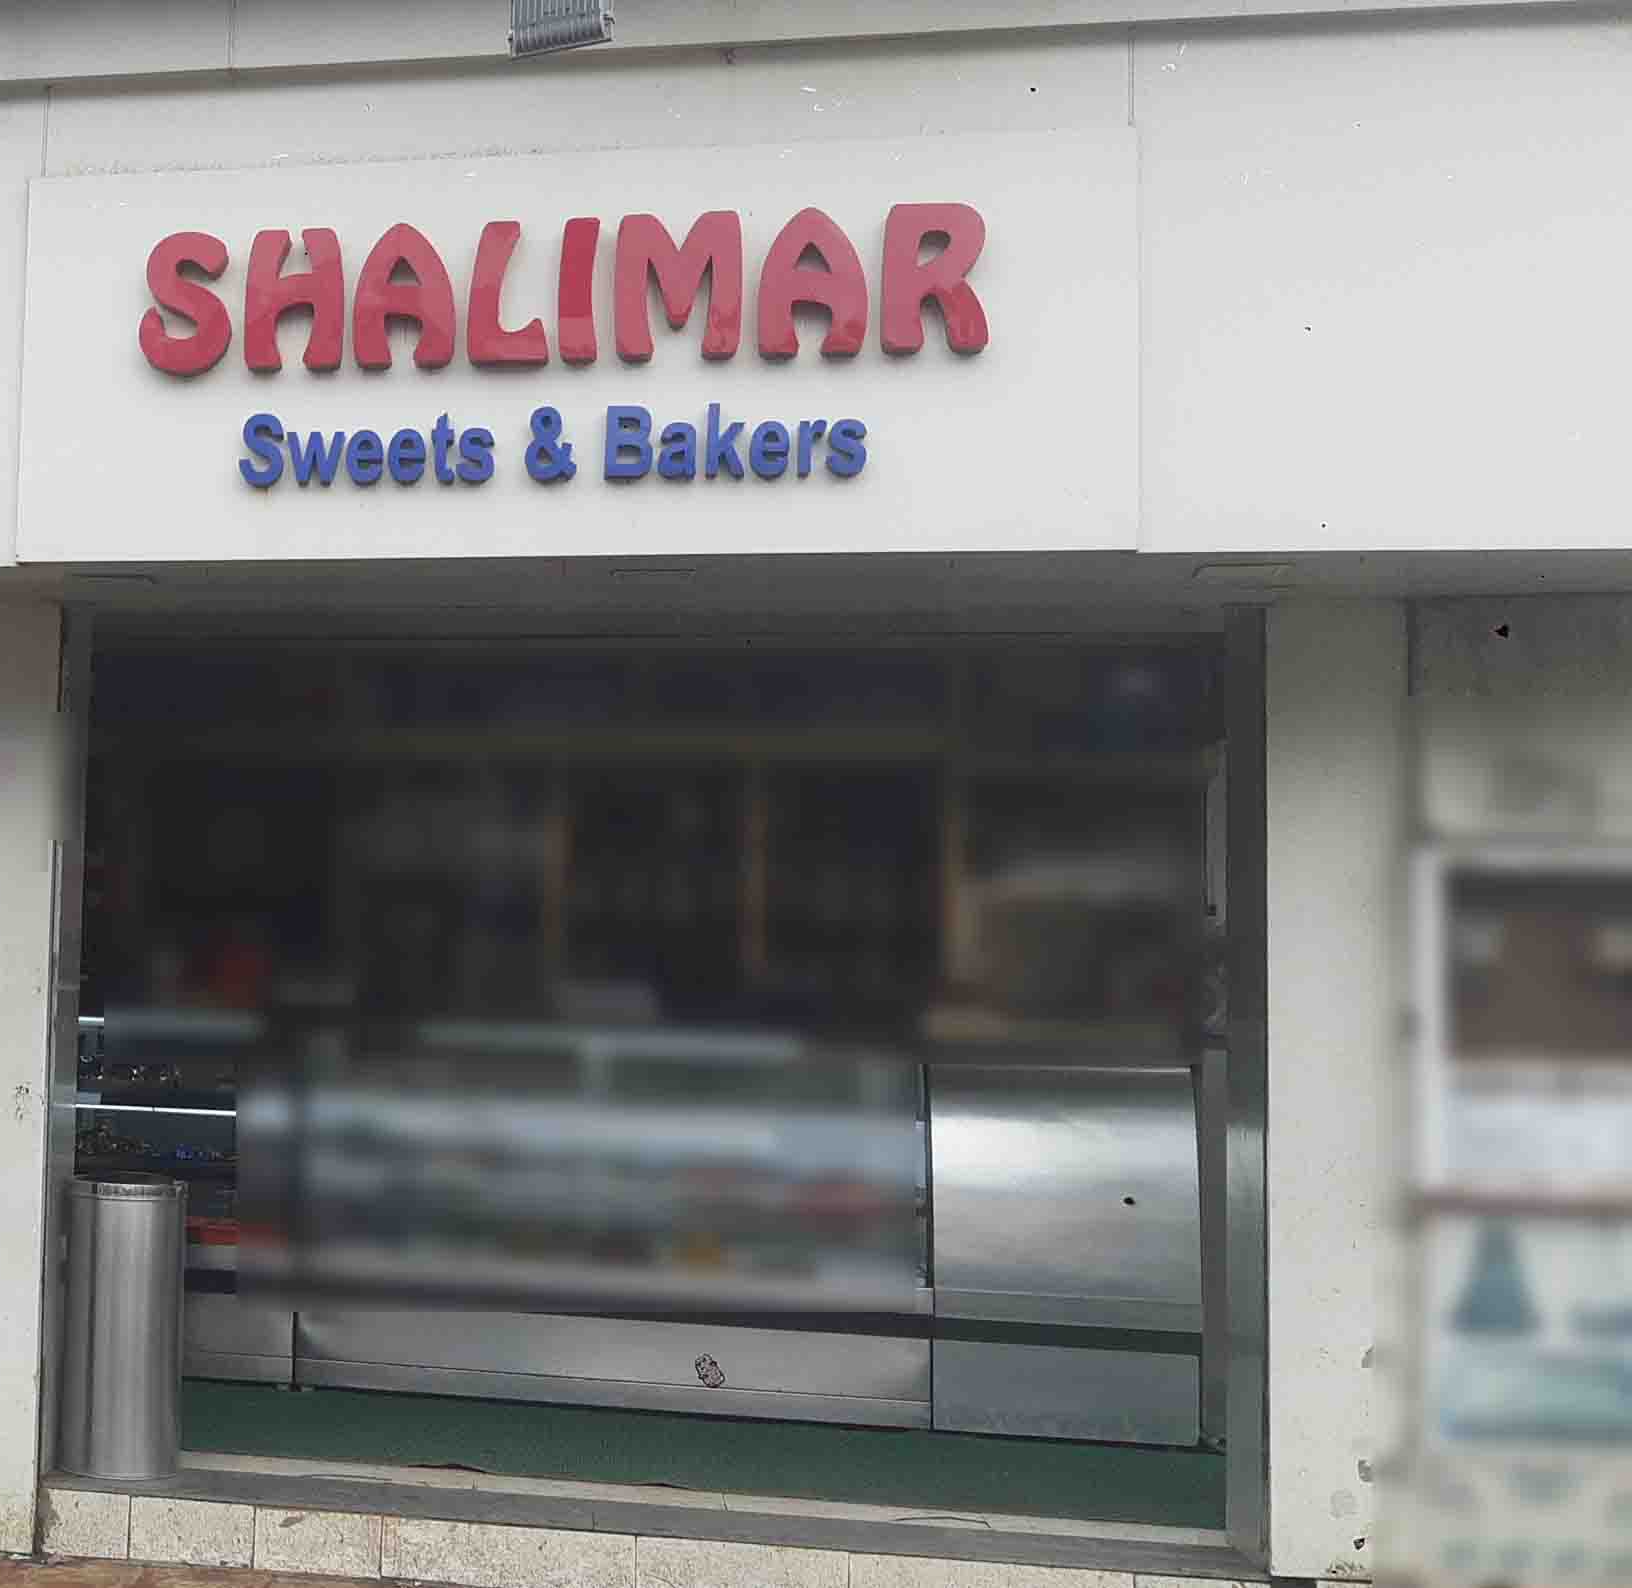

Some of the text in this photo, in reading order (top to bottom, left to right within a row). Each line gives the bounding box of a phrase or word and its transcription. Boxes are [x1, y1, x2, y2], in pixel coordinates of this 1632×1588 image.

[139, 203, 989, 377] SHALIMAR
[239, 403, 868, 488] Sweets & Bakers
